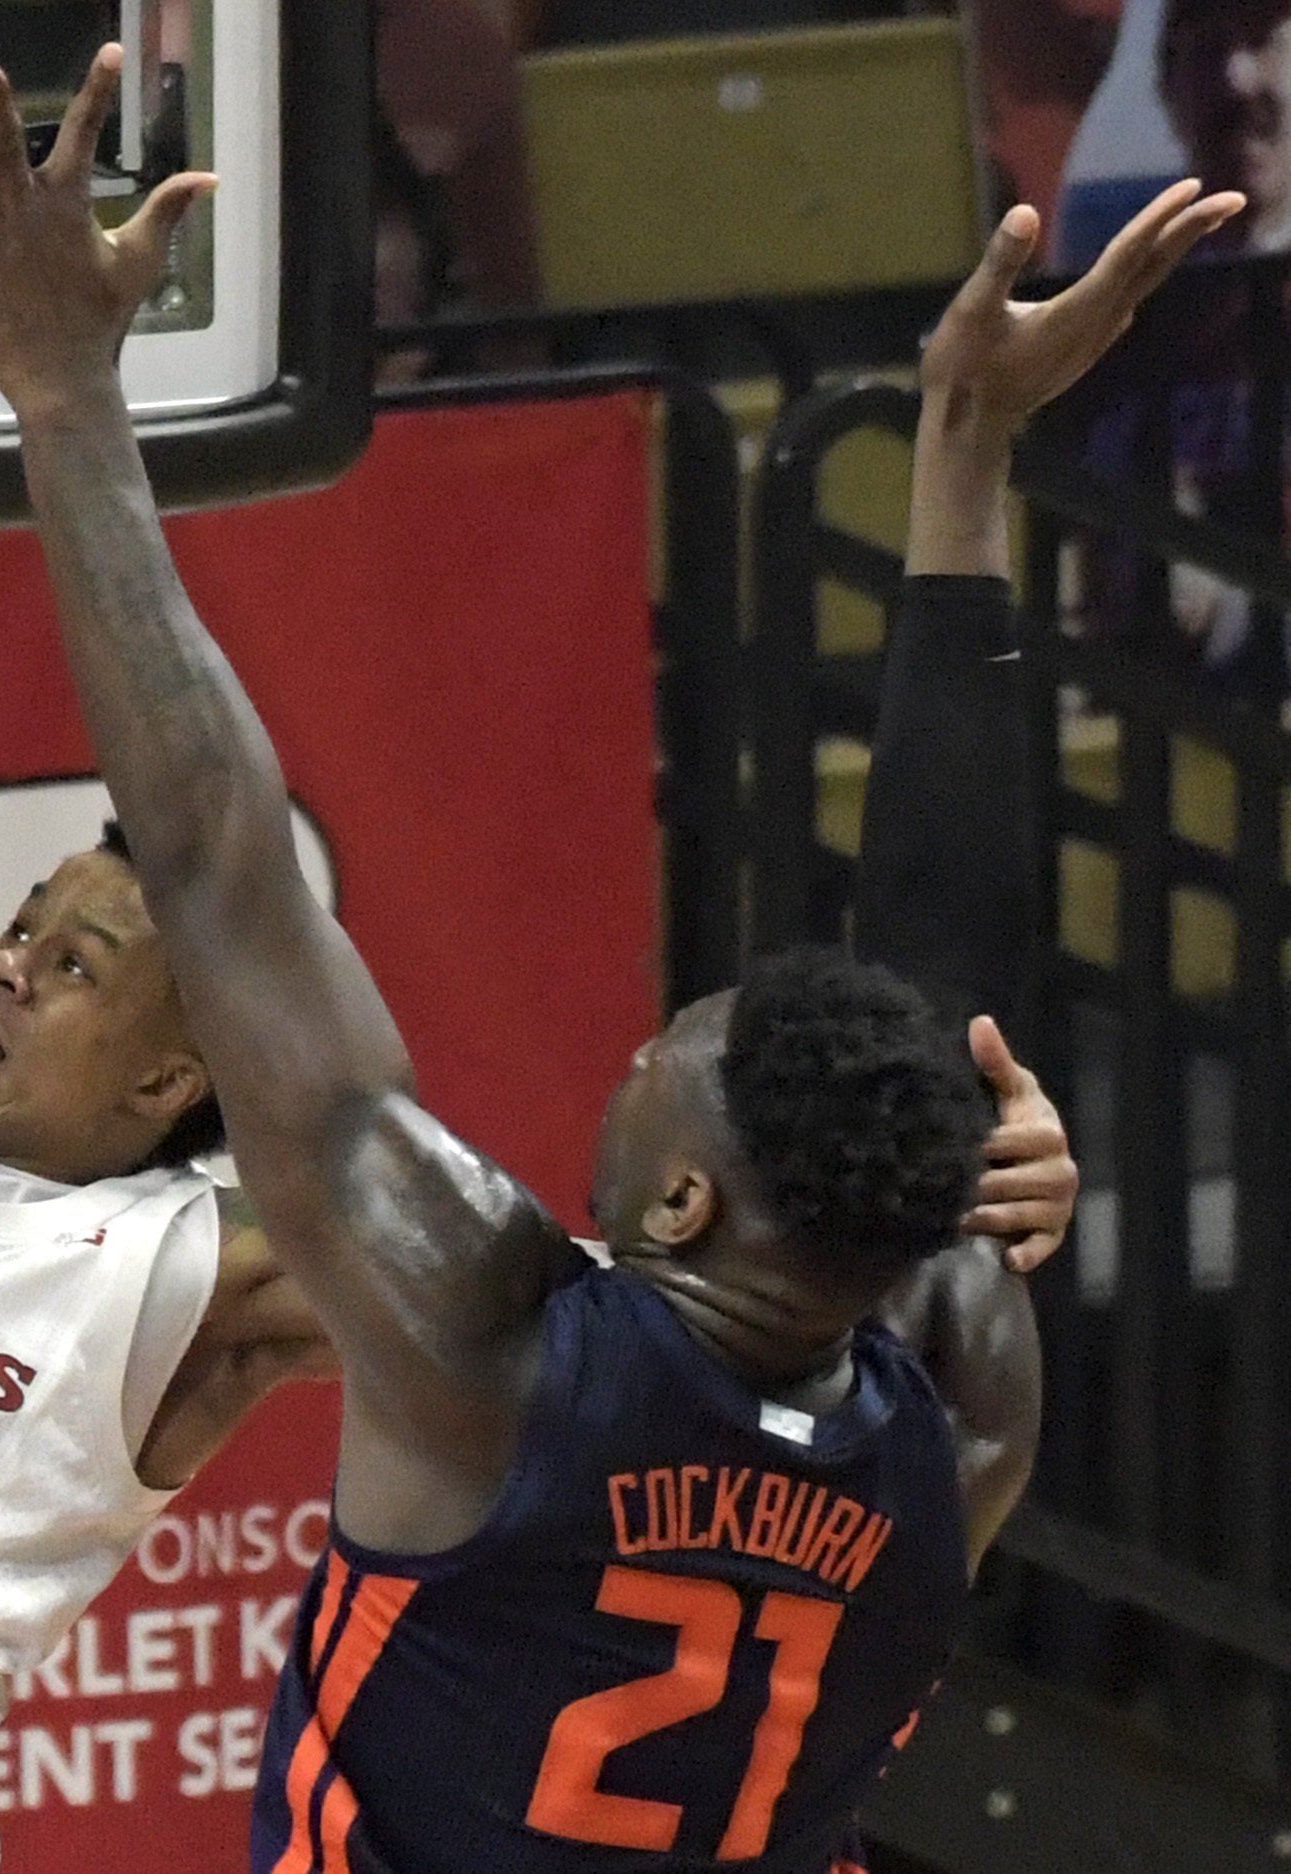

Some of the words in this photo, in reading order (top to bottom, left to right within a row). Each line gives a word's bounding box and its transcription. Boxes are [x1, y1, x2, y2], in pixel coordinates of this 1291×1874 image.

[609, 1465, 893, 1592] COCKBURN
[177, 1707, 259, 1797] SE
[525, 1564, 845, 1862] 21
